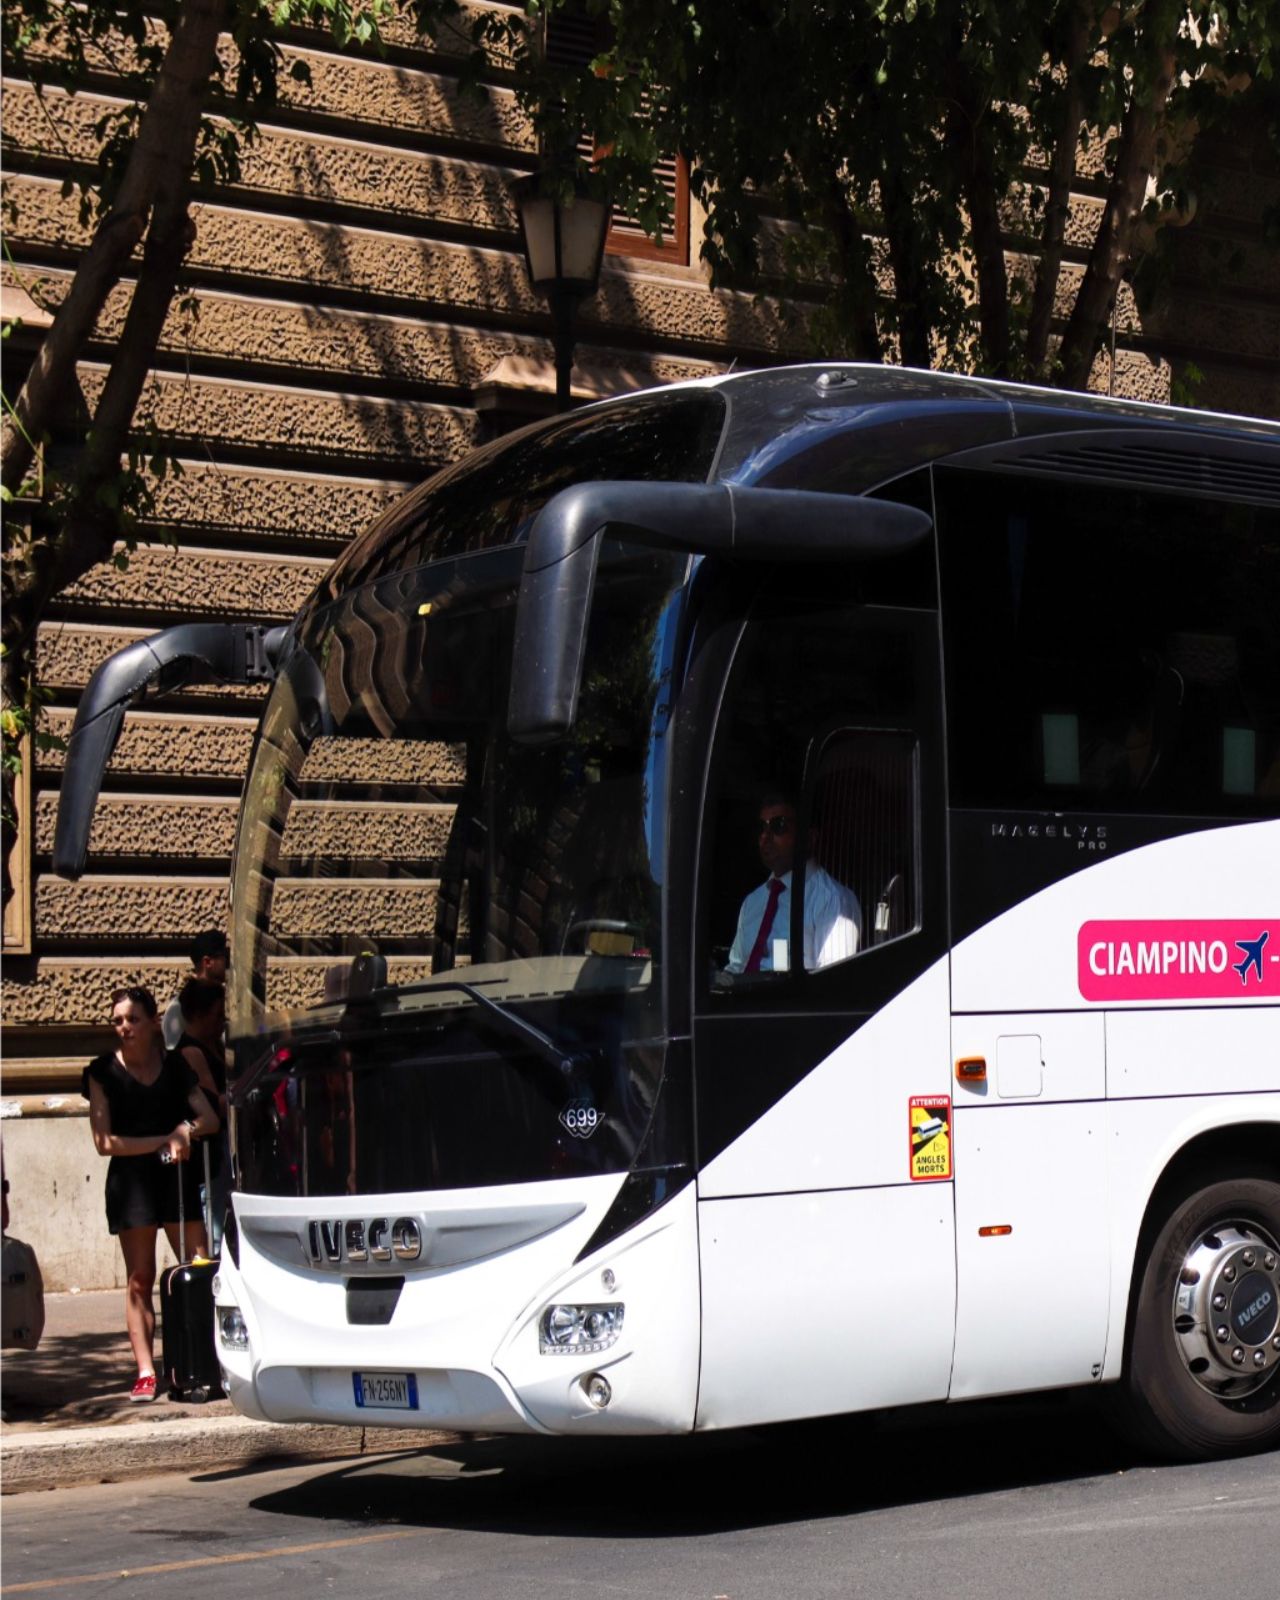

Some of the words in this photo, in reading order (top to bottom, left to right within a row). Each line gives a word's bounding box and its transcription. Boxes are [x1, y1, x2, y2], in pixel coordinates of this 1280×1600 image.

[1078, 841, 1107, 850] PRO
[1088, 940, 1229, 976] CIAMPINO
[911, 1098, 948, 1106] ATTENTION
[567, 1107, 598, 1128] 699
[916, 1155, 946, 1164] ANGLES
[917, 1164, 945, 1173] MORTS
[308, 1216, 422, 1262] IVECO
[1237, 1291, 1272, 1327] IVECO
